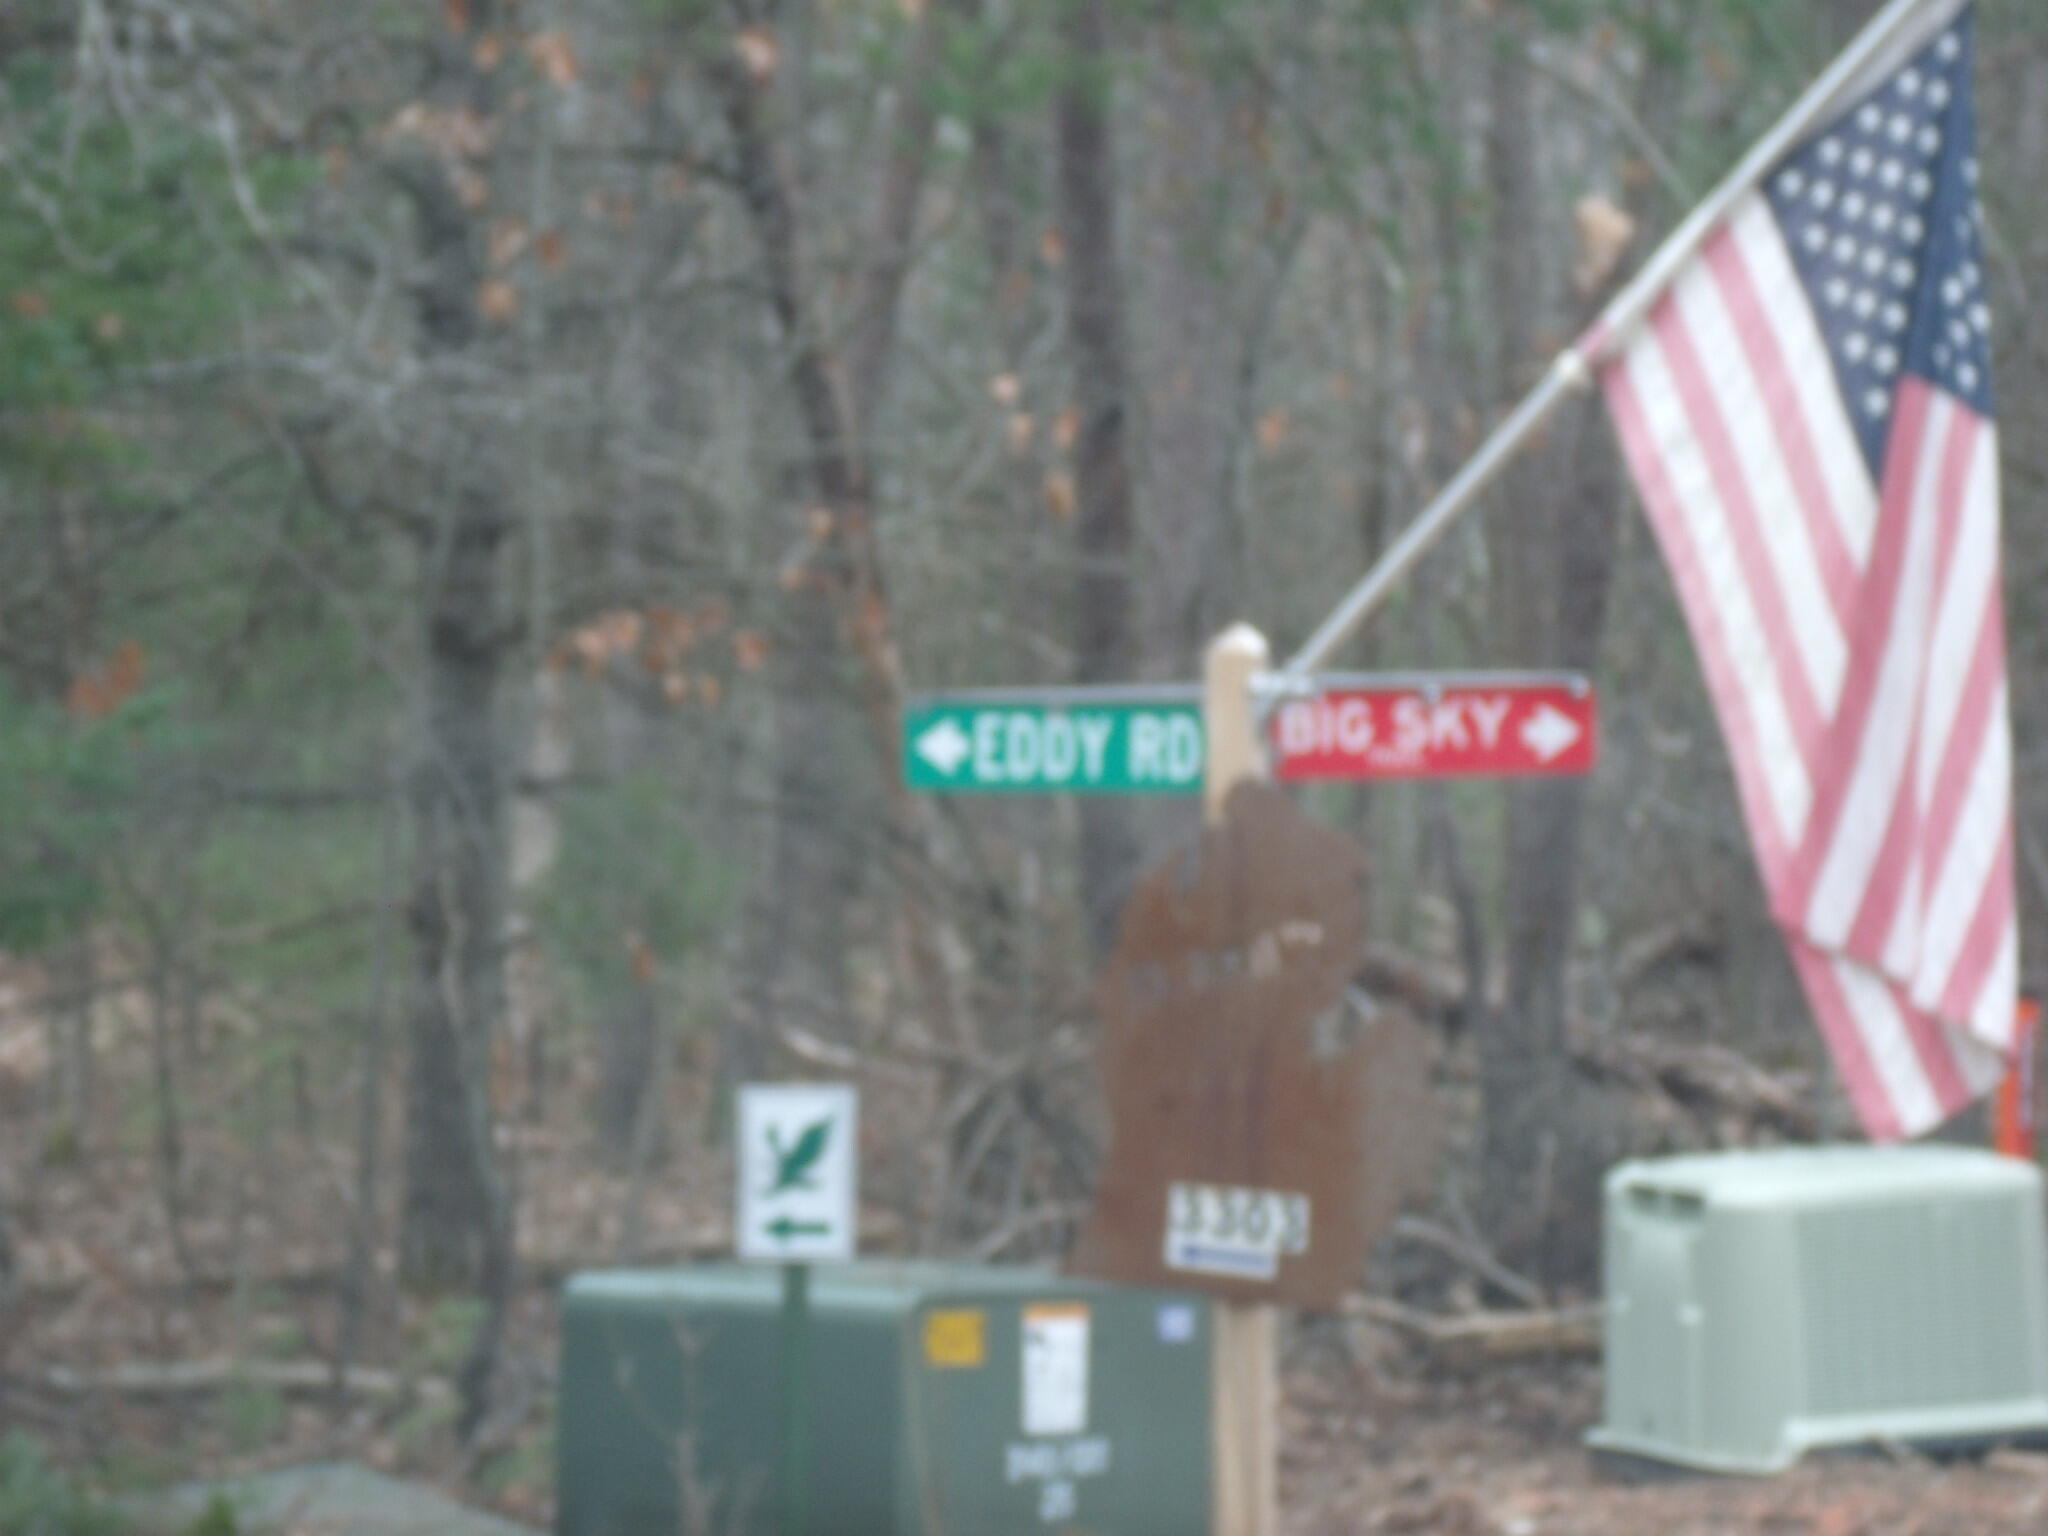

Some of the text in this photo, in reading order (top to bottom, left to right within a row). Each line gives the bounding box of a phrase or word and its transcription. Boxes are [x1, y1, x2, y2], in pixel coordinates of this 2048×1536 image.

[973, 711, 1201, 783] EDDY RD
[1279, 697, 1510, 754] BIG SKY
